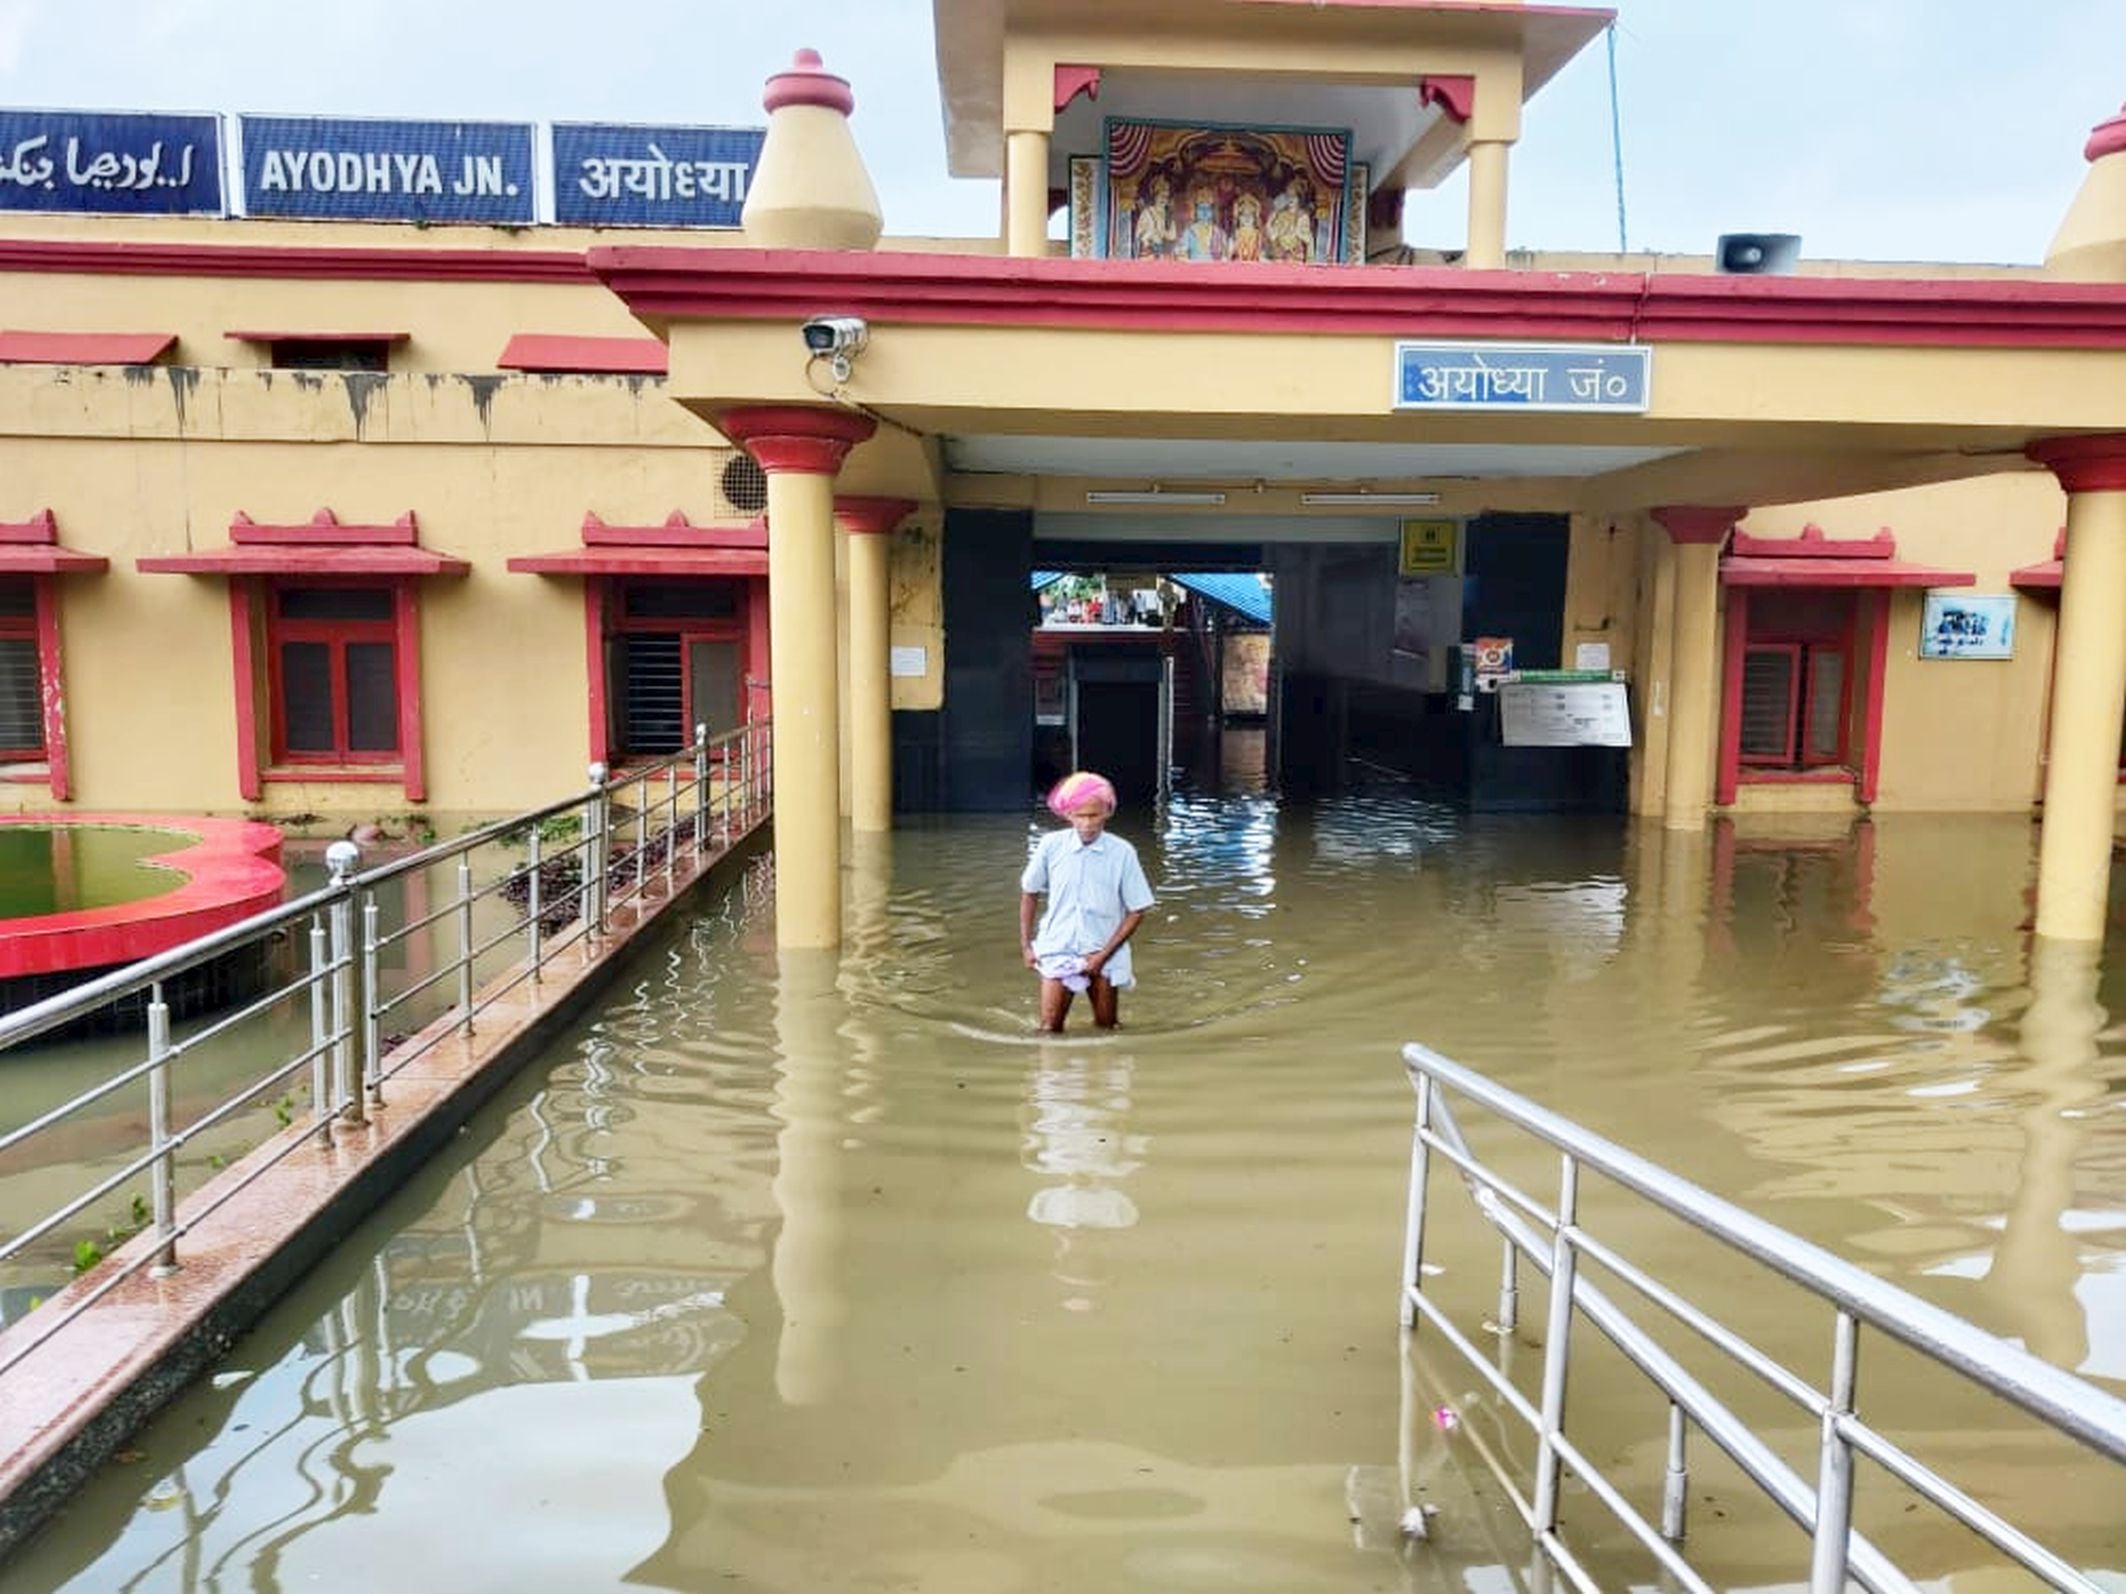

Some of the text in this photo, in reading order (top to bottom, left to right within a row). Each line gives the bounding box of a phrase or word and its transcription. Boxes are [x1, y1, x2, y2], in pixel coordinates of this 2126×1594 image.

[261, 150, 519, 196] AYODHYA JN.
[579, 142, 749, 201] अयोध्या
[1418, 353, 1549, 402] अयोध्या
